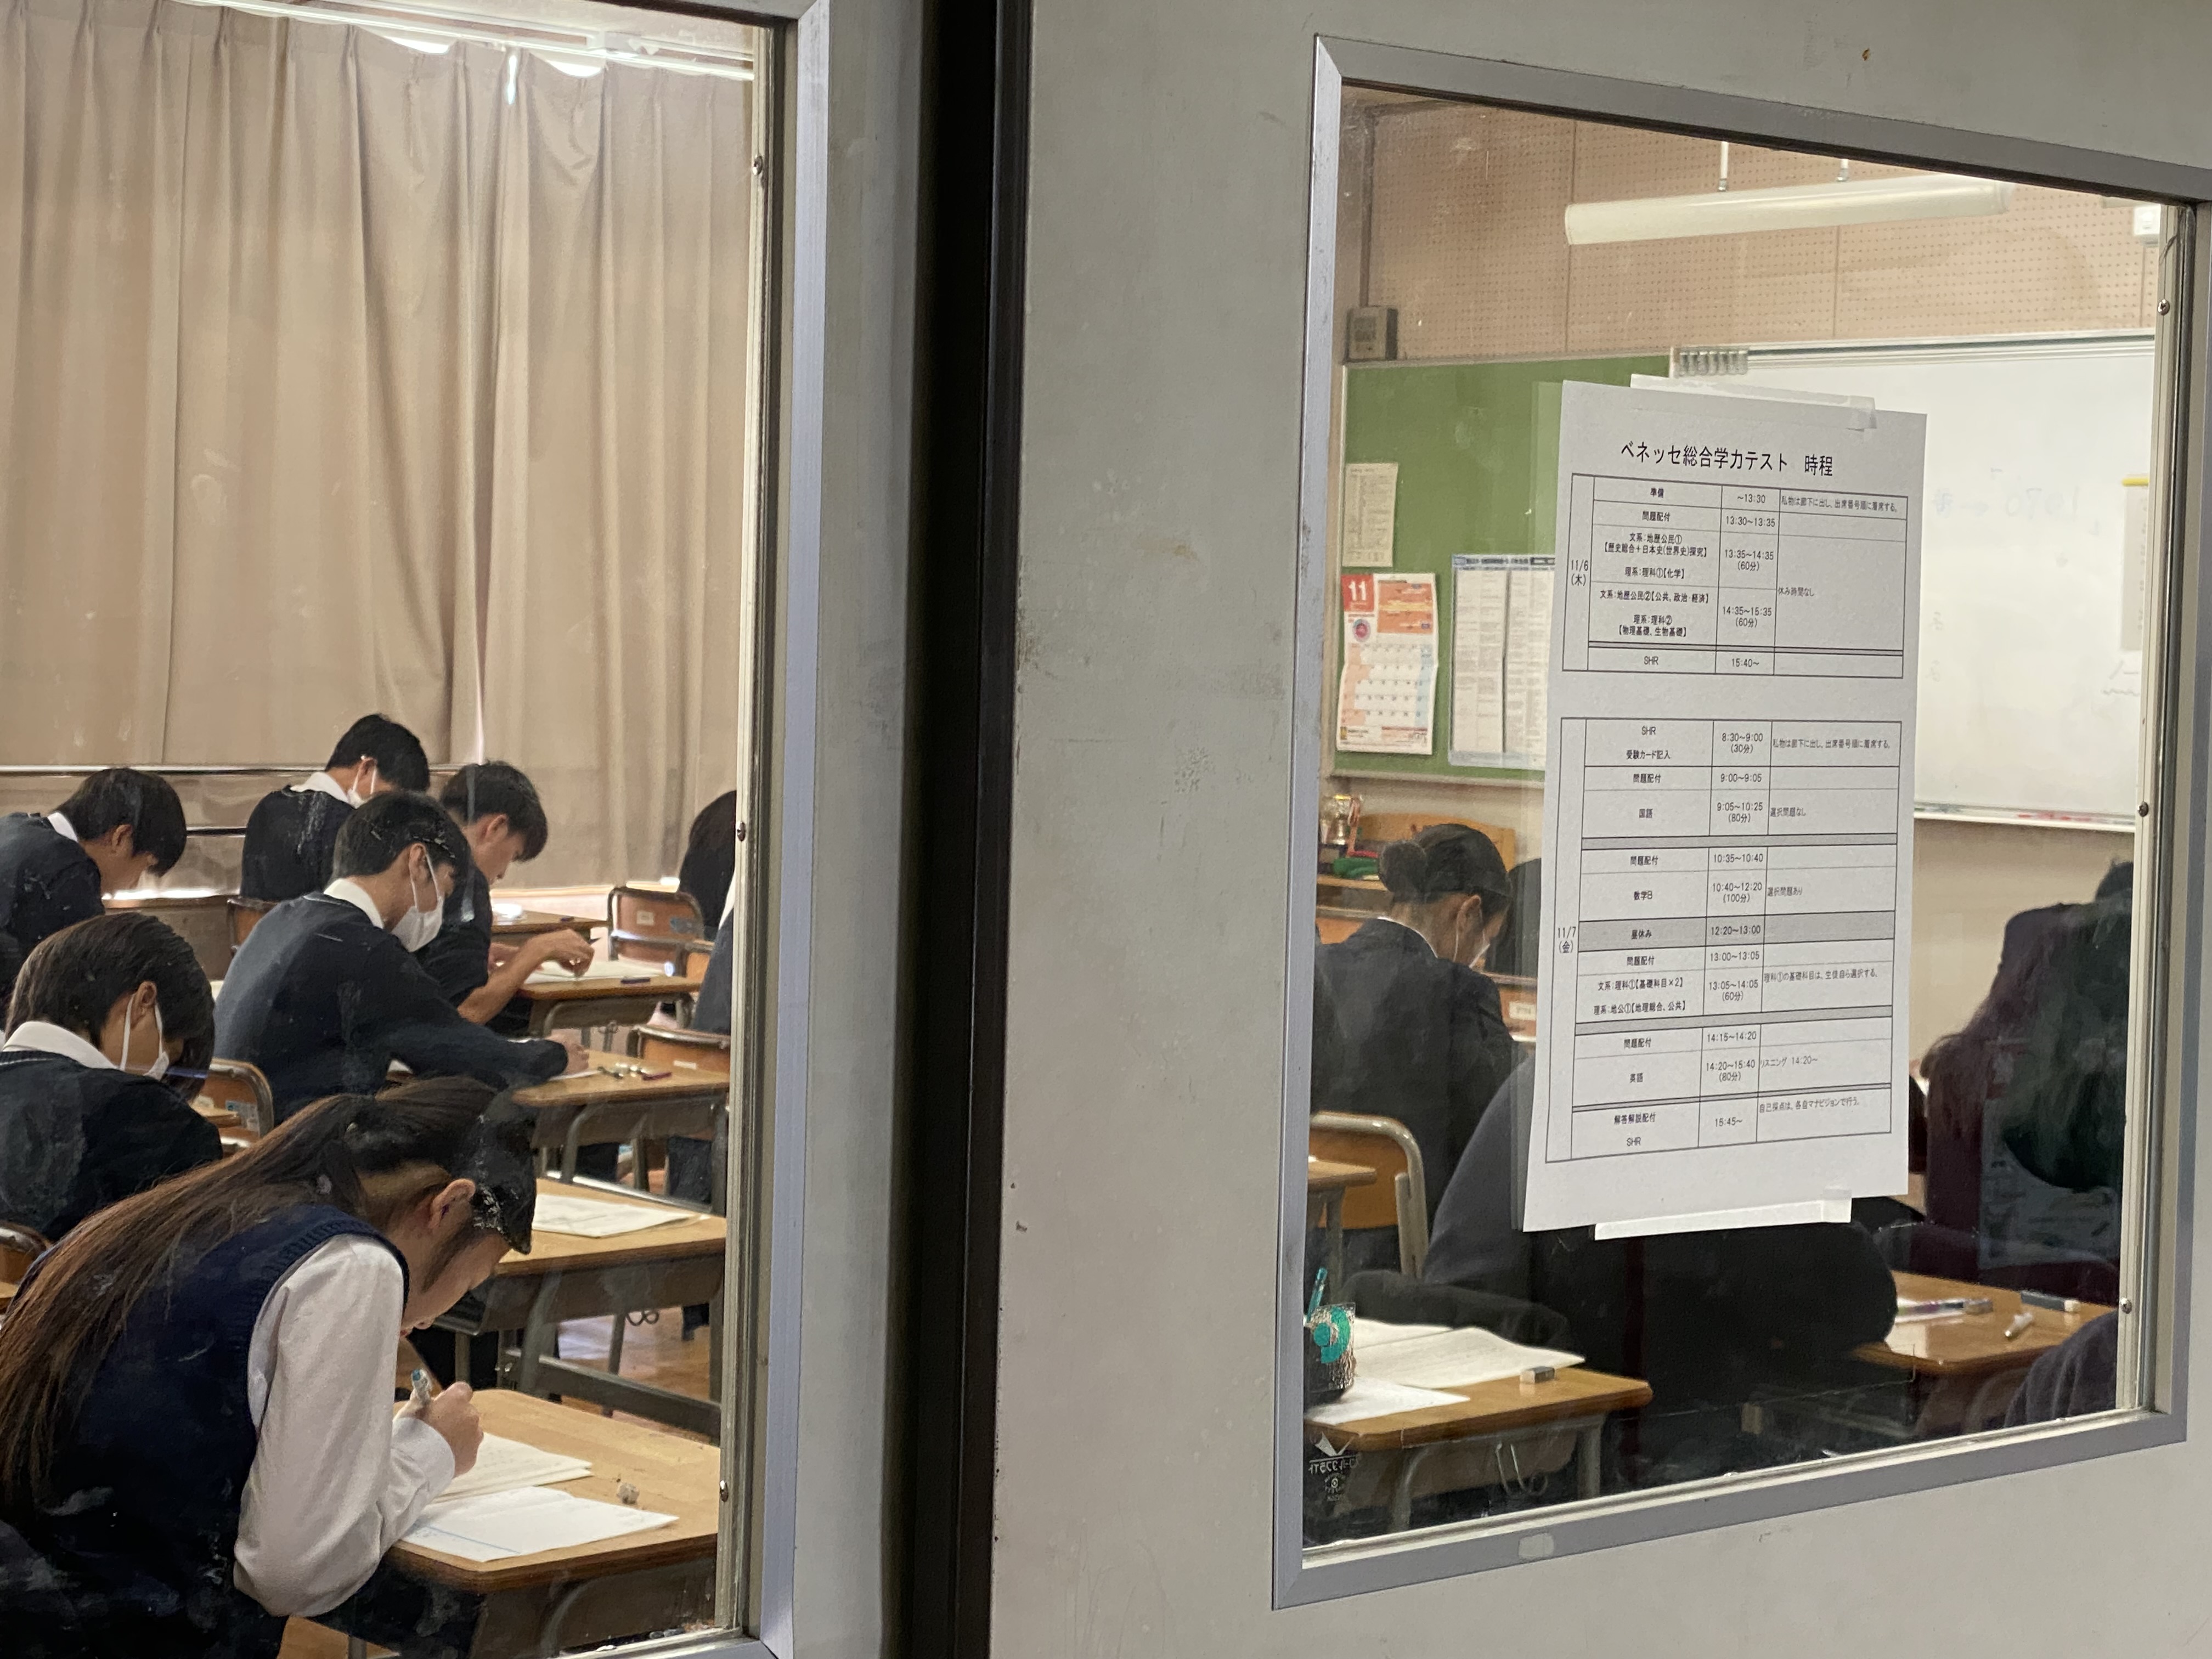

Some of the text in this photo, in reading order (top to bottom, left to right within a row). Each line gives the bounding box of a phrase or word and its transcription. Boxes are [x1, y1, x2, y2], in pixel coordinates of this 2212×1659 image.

[1622, 441, 1832, 476] ベネッセ総合学力テスト 時程
[1651, 488, 1663, 498] 準備
[1643, 511, 1670, 521] 問題配付
[1572, 560, 1588, 572] 11/6
[1348, 580, 1367, 601] 11
[1778, 586, 1814, 597] 休み時間なし
[1644, 656, 1658, 665] SHR
[1642, 726, 1656, 735] SHR
[1627, 750, 1670, 759] 受験カード記入
[1633, 774, 1661, 783] 問題配付
[1639, 809, 1652, 818] 国語
[1770, 807, 1806, 817] 選択問題なし
[1630, 856, 1658, 866] 問題配付
[1768, 887, 1802, 896] 選択問題あり
[1558, 926, 1576, 939] 11/7
[1632, 929, 1651, 939] 昼休み
[1627, 956, 1654, 966] 問題配付
[1624, 1038, 1651, 1048] 問題配付
[1760, 1057, 1787, 1068] リスニング
[1630, 1073, 1643, 1082] 英語
[1615, 1113, 1656, 1124] 解答解説配付
[1627, 1137, 1641, 1146] SHR
